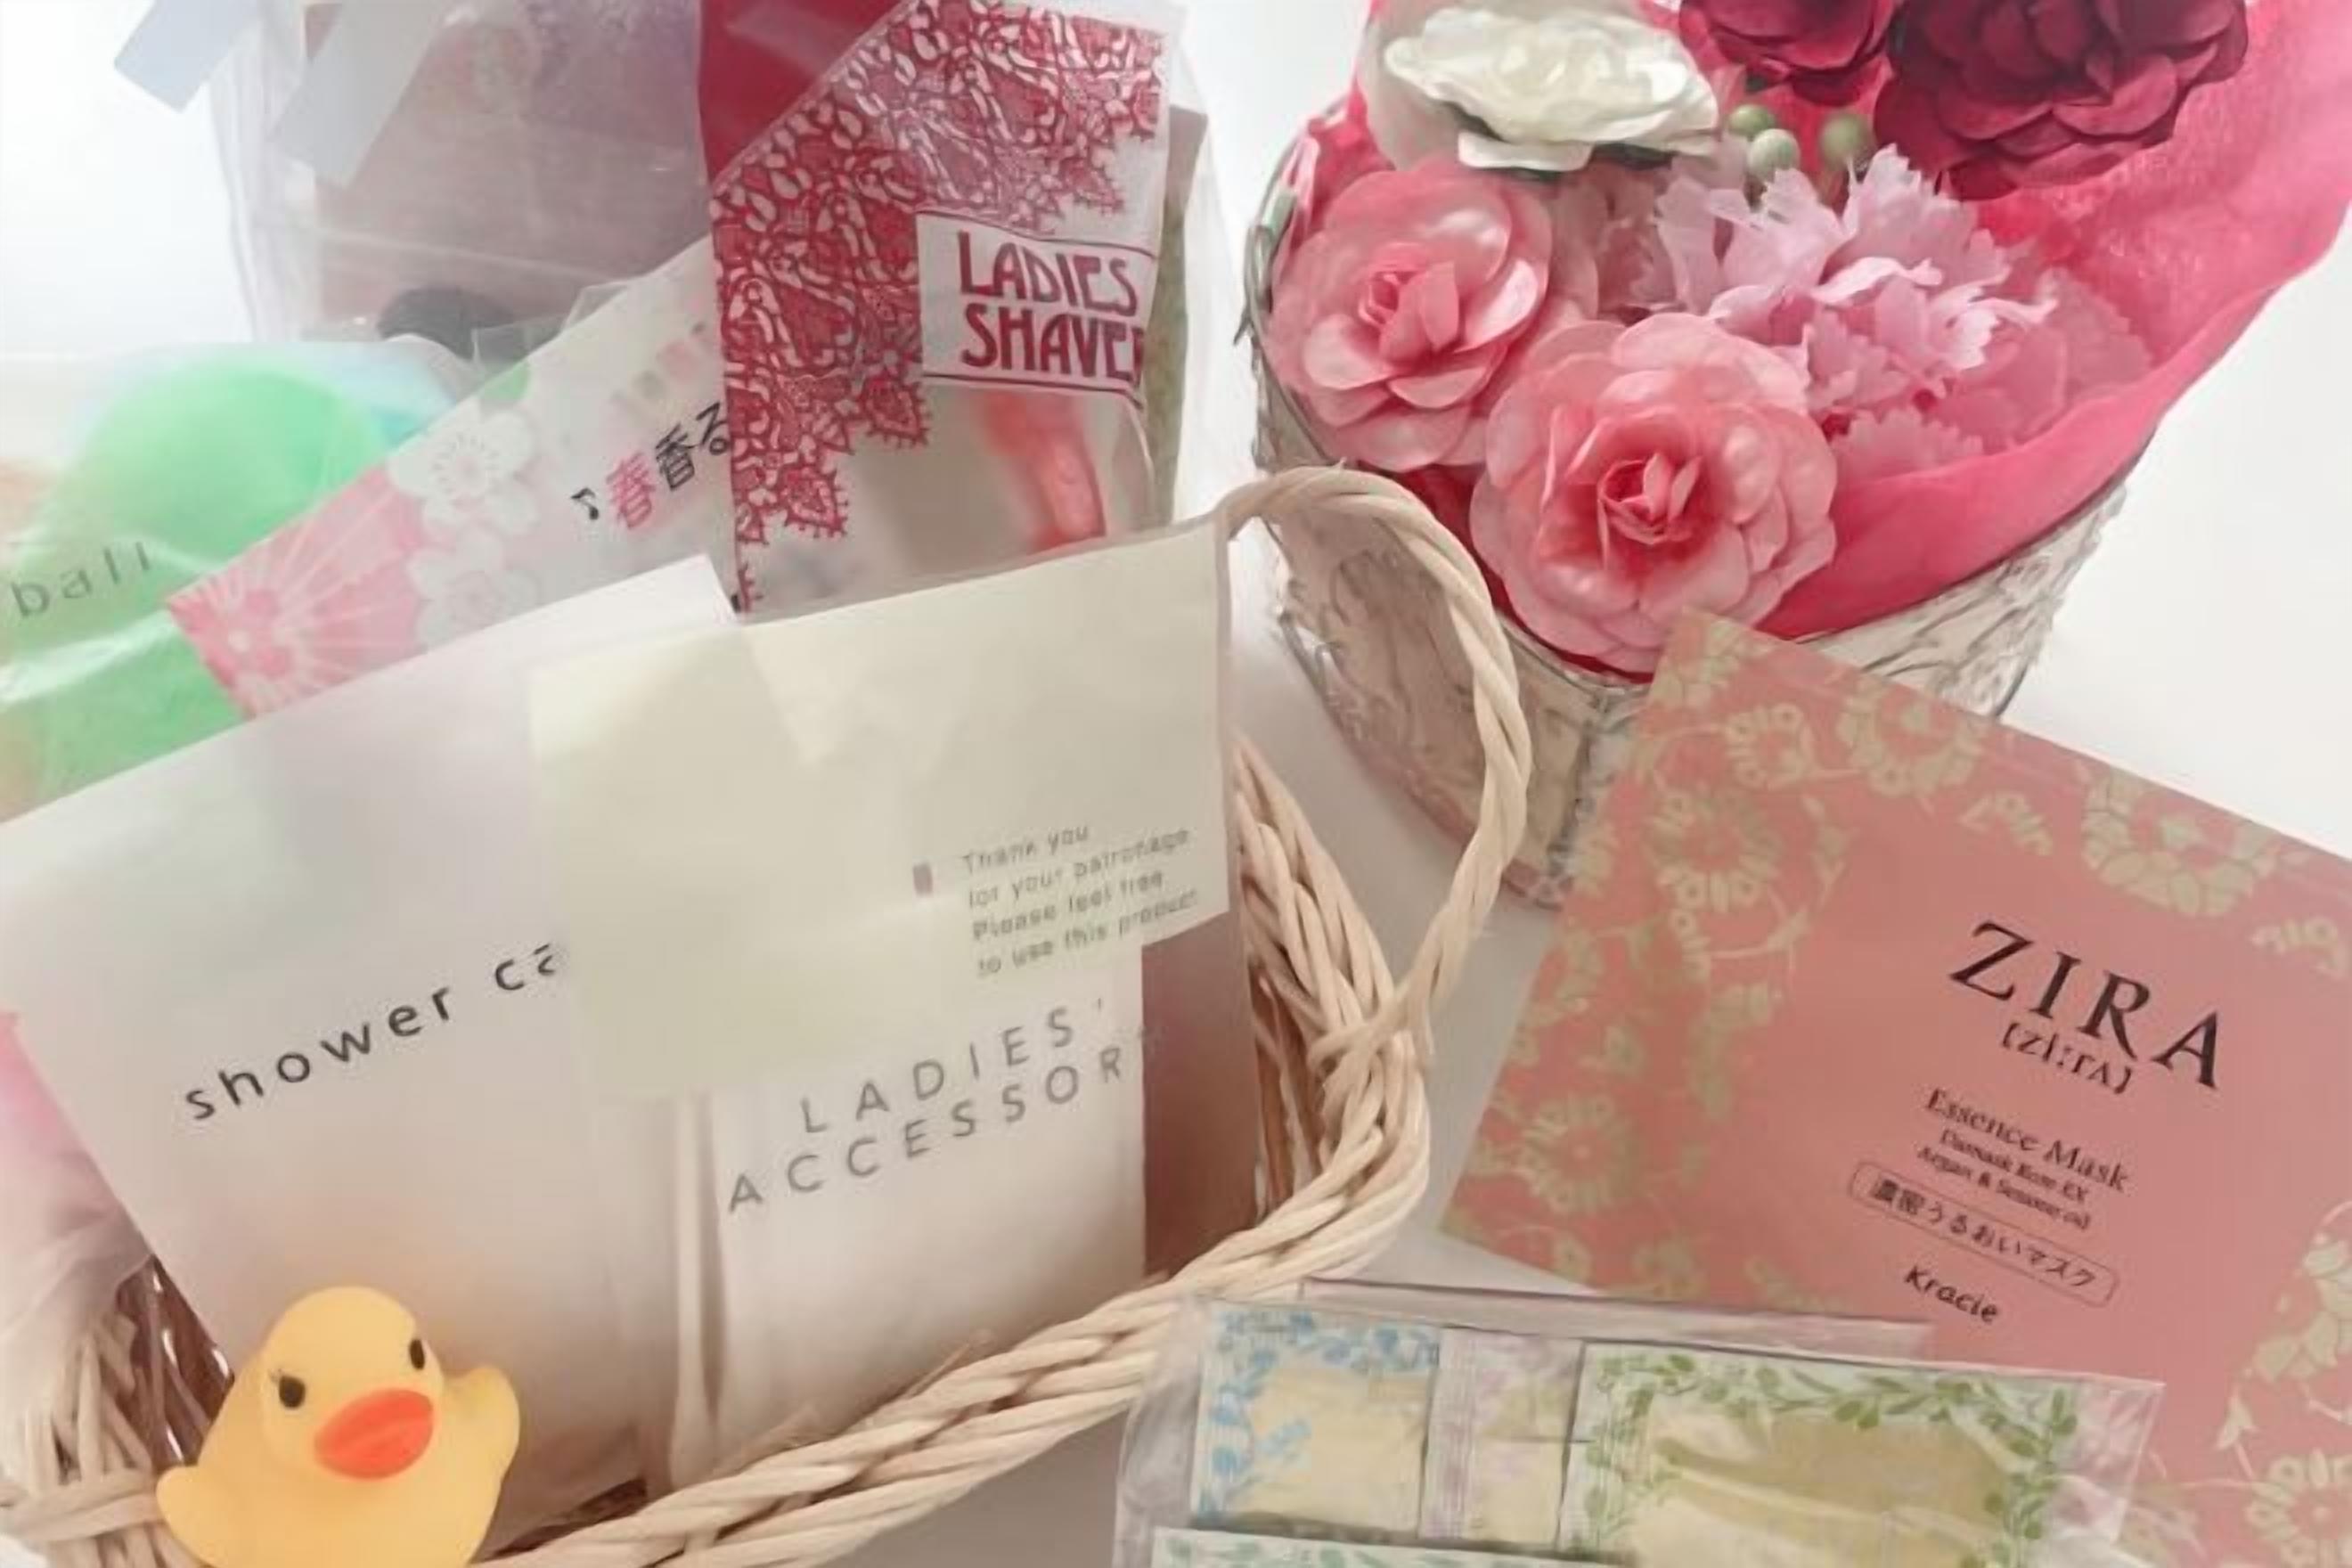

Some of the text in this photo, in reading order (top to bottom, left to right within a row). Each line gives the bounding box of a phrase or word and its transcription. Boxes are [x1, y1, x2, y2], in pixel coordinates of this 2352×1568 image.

[958, 229, 1138, 317] LADIES
[962, 826, 1089, 875] Thank you
[1011, 867, 1064, 902] your
[1949, 919, 2218, 1090] ZIRA
[185, 986, 451, 1121] shower
[728, 1035, 1154, 1213] ACCESSOR
[1927, 1087, 2128, 1194] Essence Mask
[1903, 1257, 1999, 1325] Kracie
